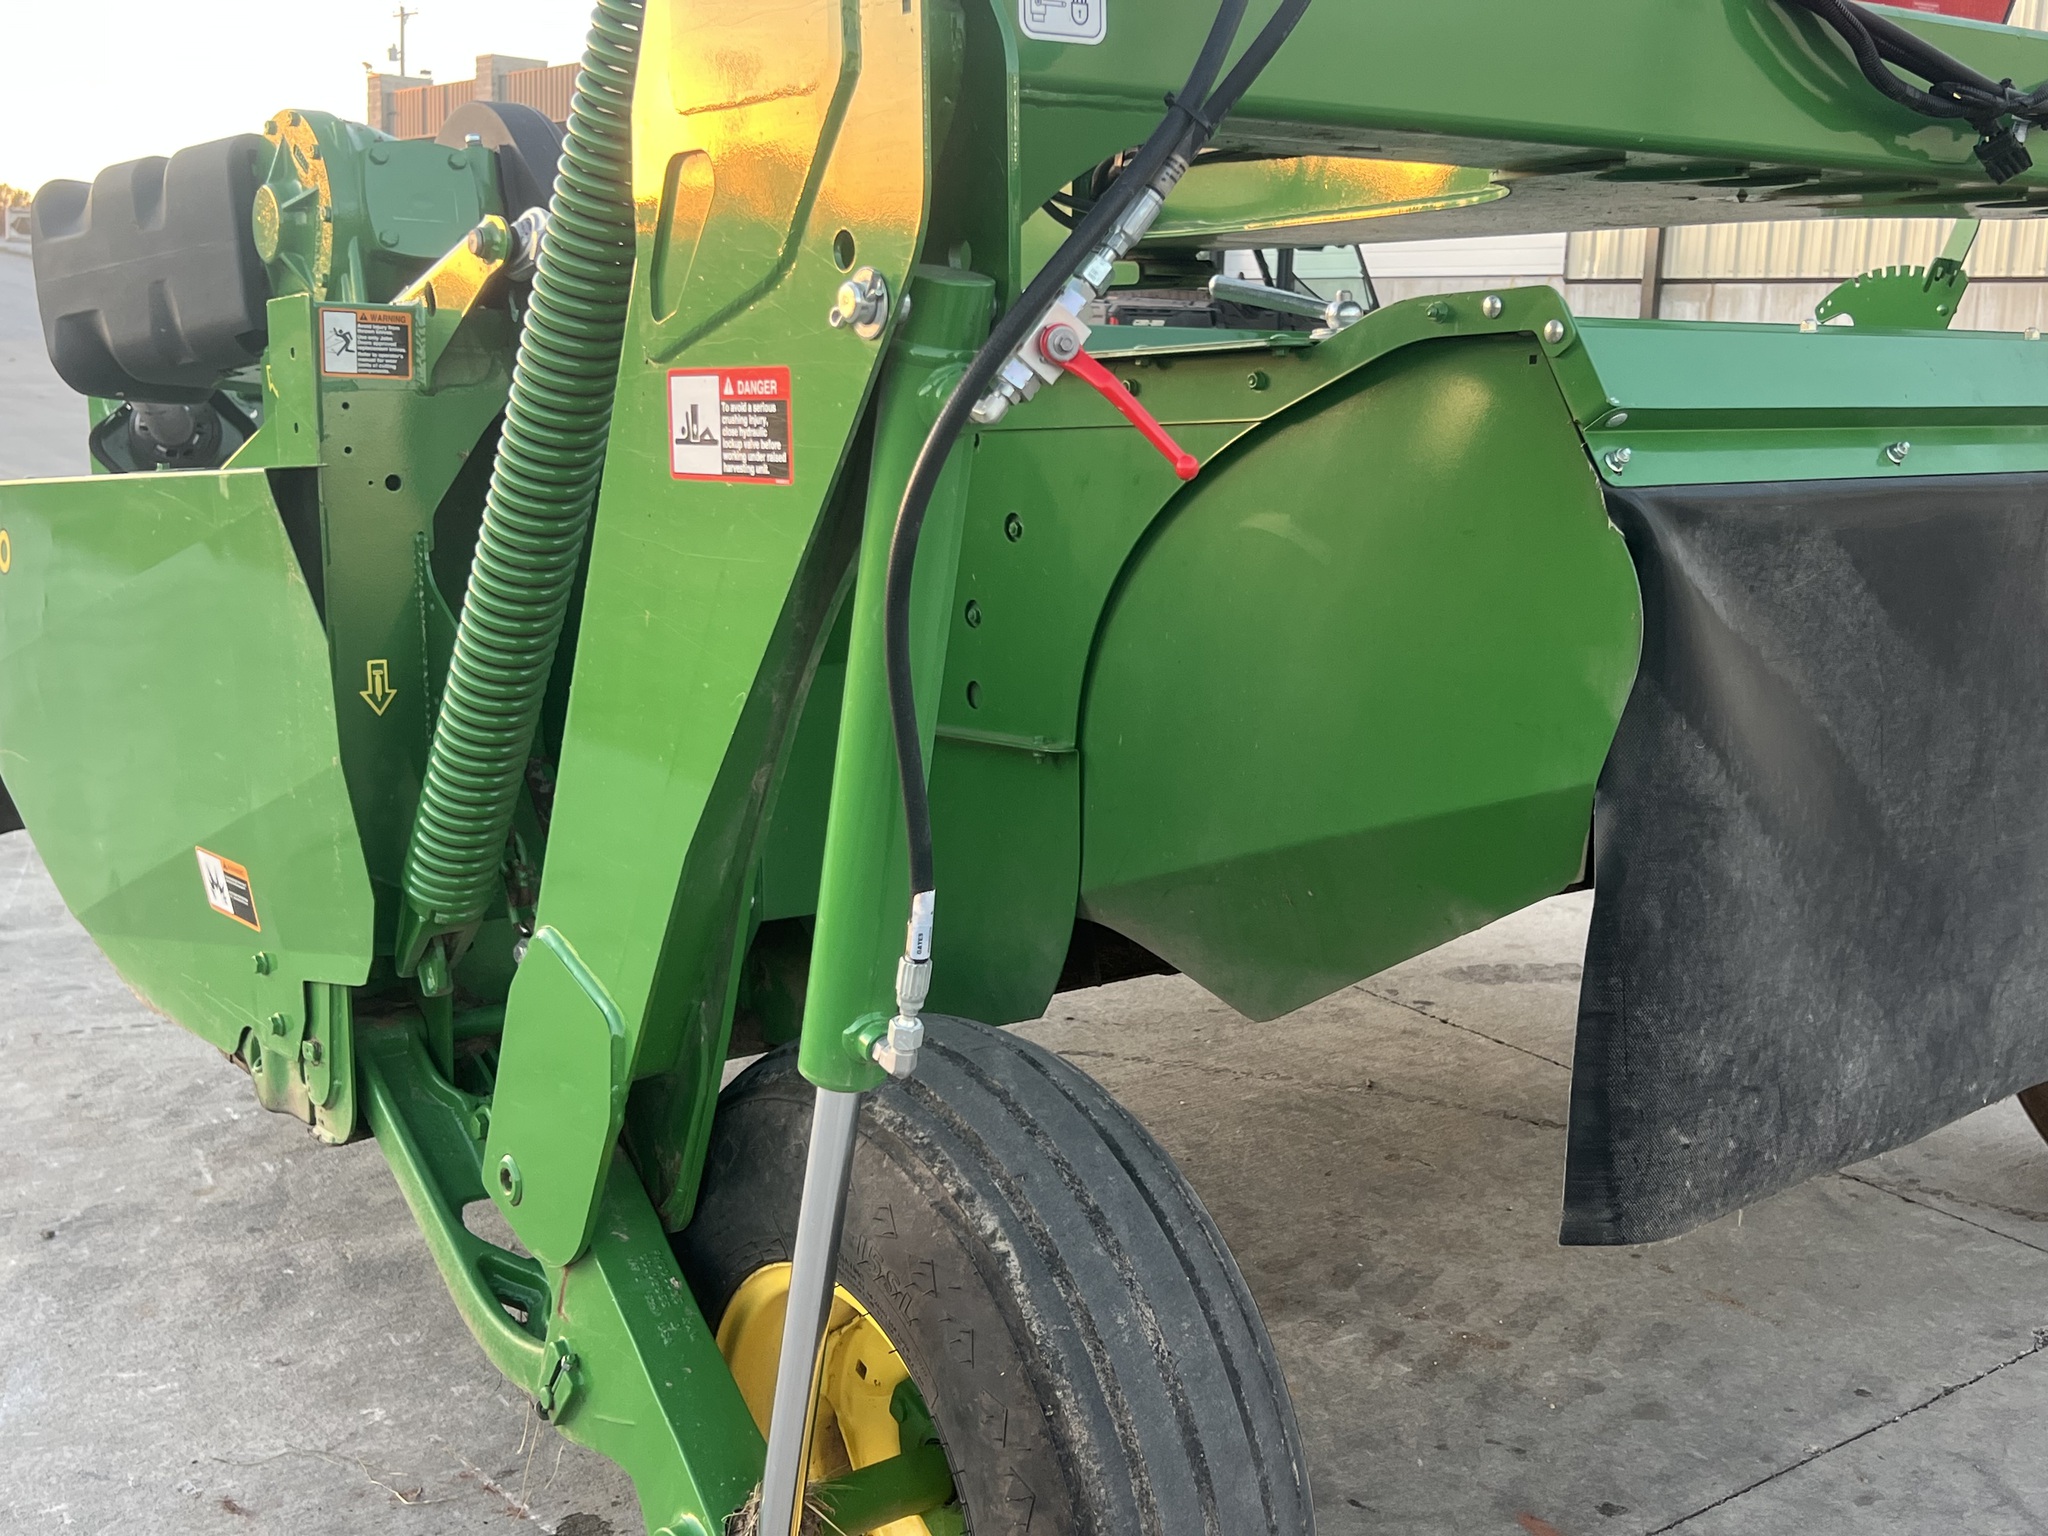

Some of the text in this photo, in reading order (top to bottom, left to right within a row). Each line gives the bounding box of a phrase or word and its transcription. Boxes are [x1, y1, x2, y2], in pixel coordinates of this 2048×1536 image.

[370, 314, 406, 323] WARNING
[737, 380, 777, 395] DANGER
[721, 402, 776, 412] To avoid a serious
[722, 415, 768, 427] crushing injury,
[722, 427, 767, 439] close hydraulic
[723, 440, 781, 450] lockup valve before
[723, 452, 787, 463] working under raised
[723, 464, 755, 476] harvesting
